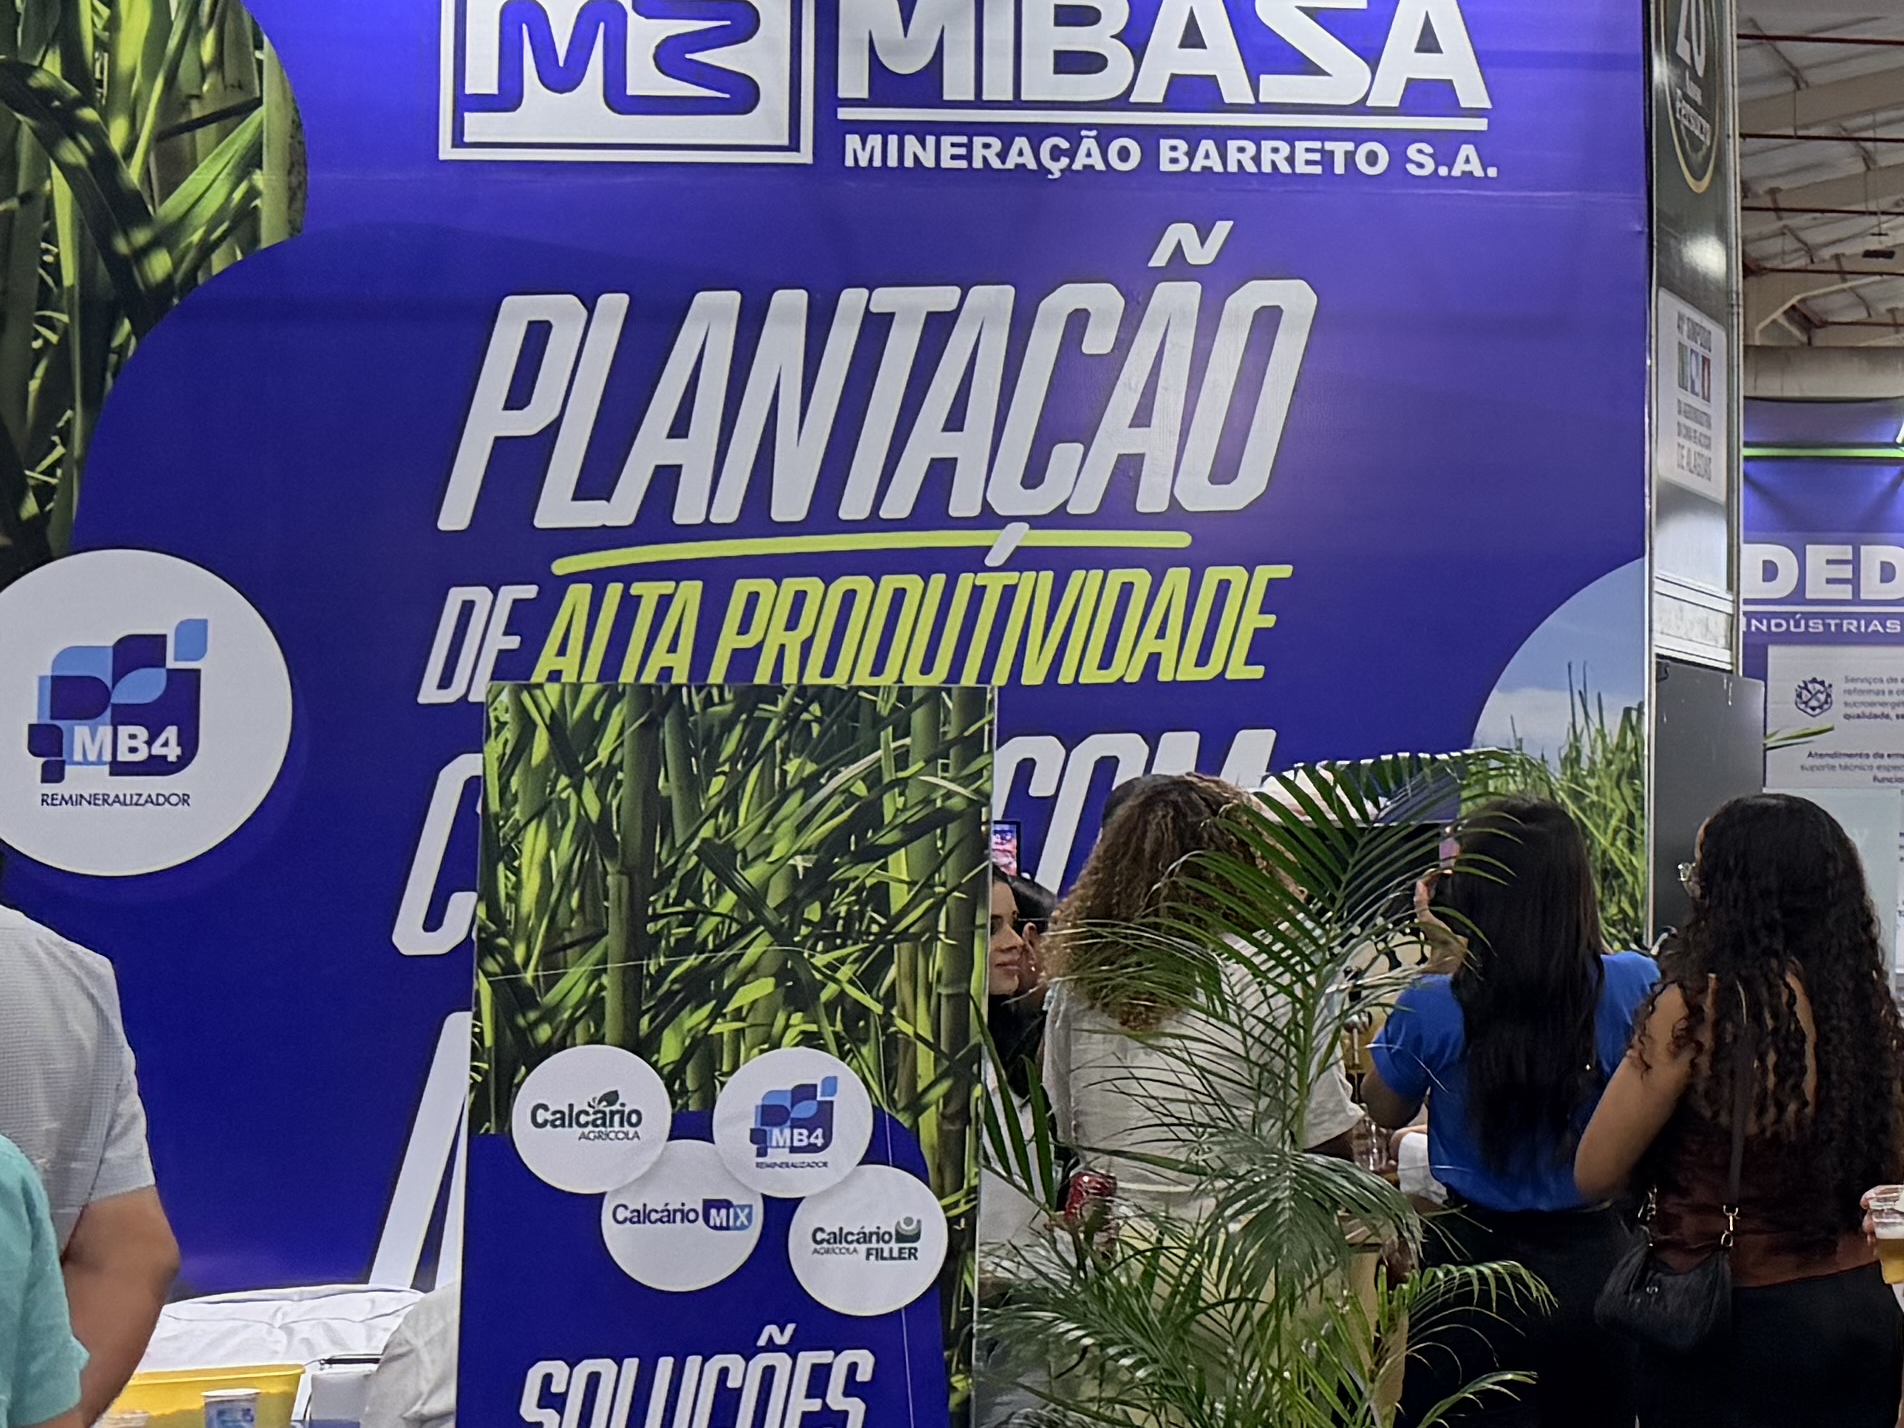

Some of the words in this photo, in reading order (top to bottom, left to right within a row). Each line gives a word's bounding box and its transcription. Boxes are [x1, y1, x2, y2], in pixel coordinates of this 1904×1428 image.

[842, 127, 1141, 180] MINERAÇÃO
[1159, 138, 1390, 177] BARRETO
[1405, 143, 1500, 180] S.A.
[436, 219, 1319, 567] PLANTAÇÃO
[417, 584, 540, 704] DE
[532, 579, 704, 683] ALTA
[709, 564, 1294, 685] PRODUTIVIDADE
[73, 724, 182, 762] MB4
[40, 792, 191, 808] REMINERALIZADOR
[770, 1127, 825, 1148] MB4
[611, 1201, 700, 1226] Calcário
[708, 1205, 751, 1229] MIX
[811, 1224, 893, 1247] Calcário
[865, 1246, 919, 1262] FILLER
